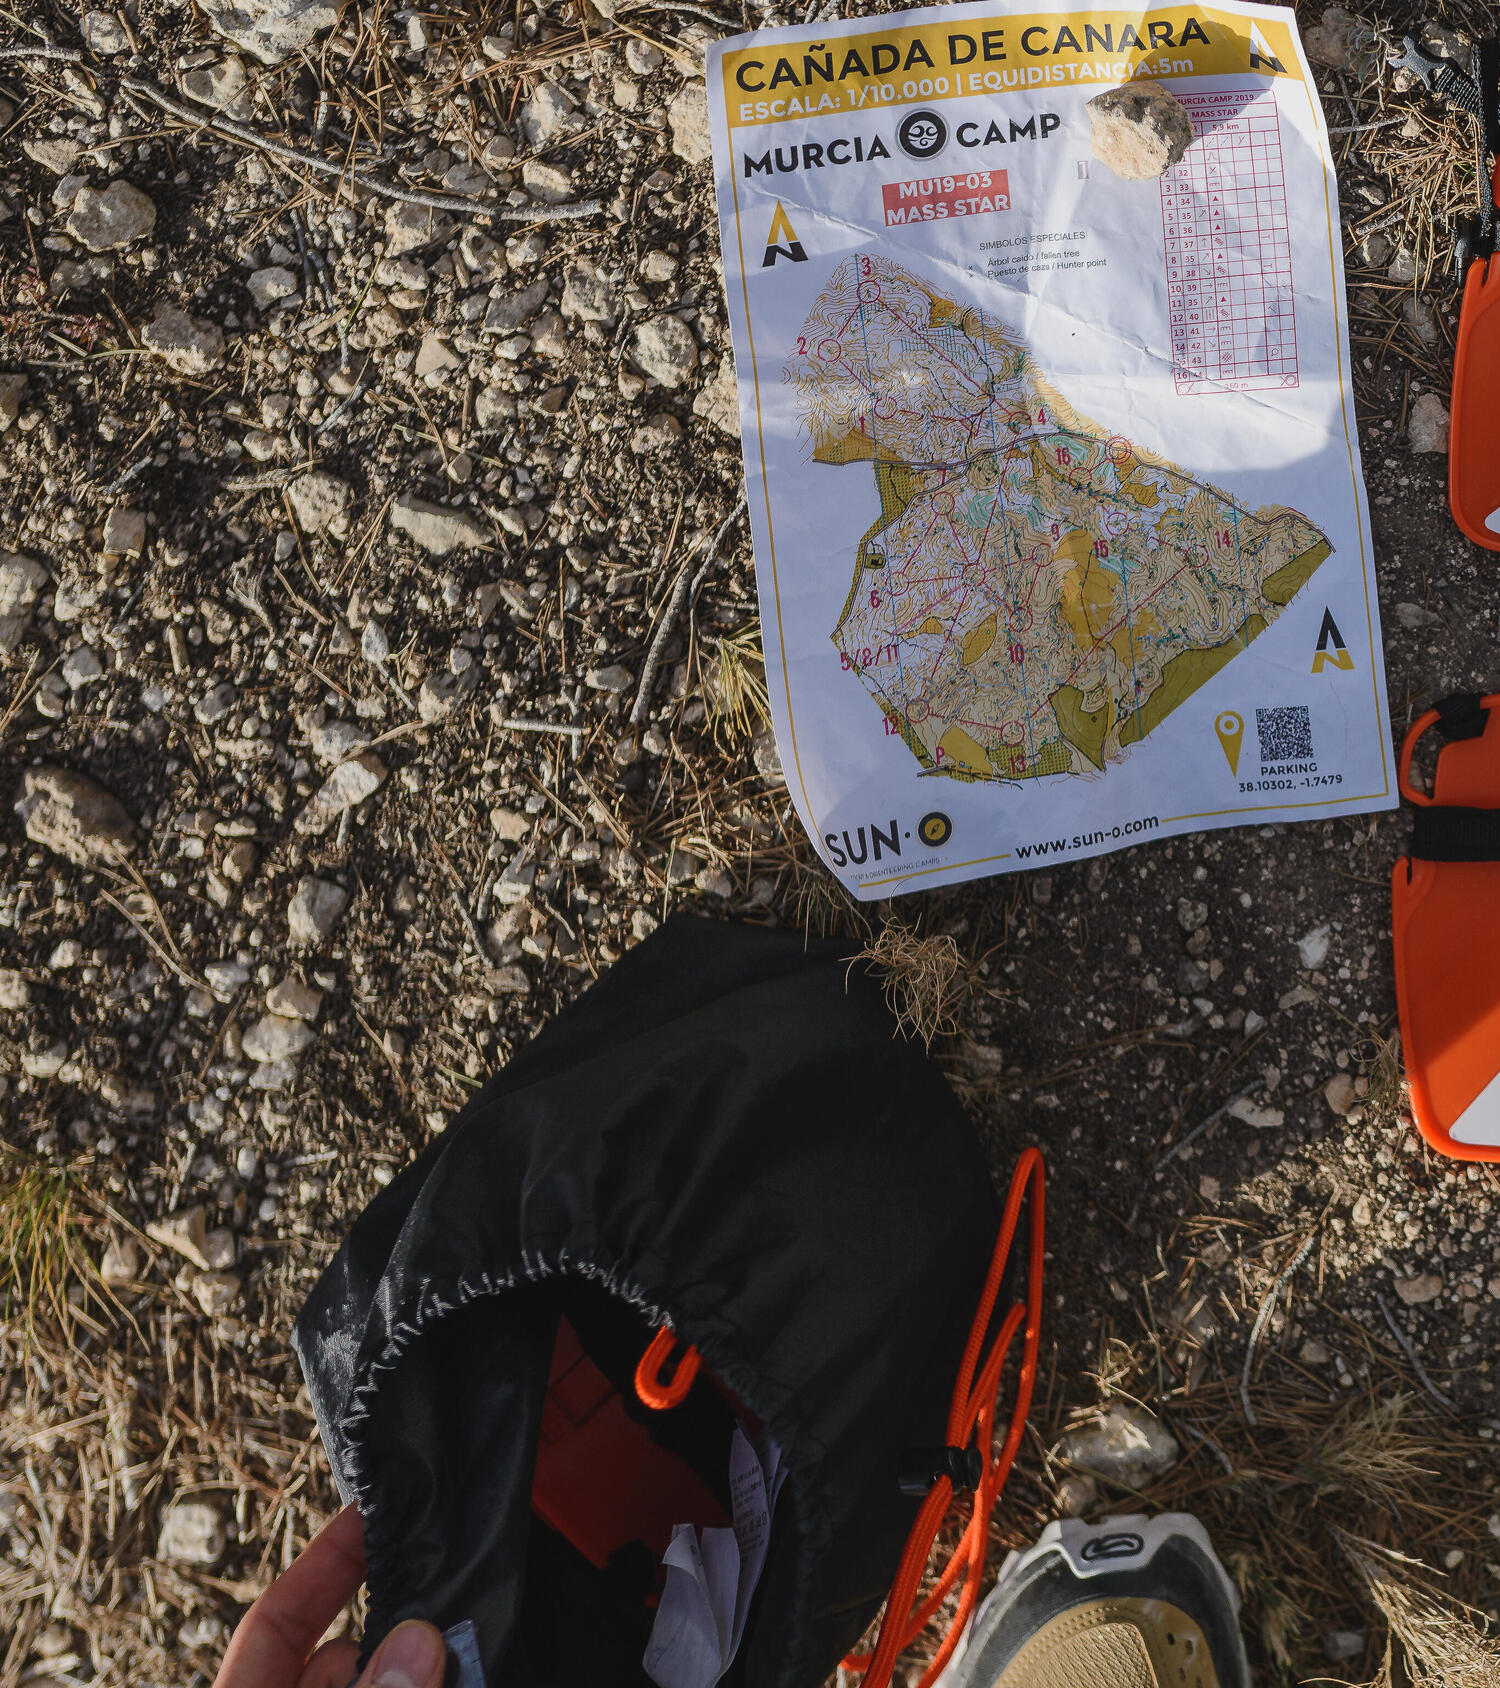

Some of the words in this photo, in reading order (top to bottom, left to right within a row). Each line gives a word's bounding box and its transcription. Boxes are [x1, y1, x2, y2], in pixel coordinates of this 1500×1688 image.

[736, 38, 935, 92] CAÑADA
[948, 29, 1007, 66] DE
[1021, 17, 1211, 57] CANARA
[739, 93, 841, 121] ESCALA:
[846, 76, 950, 108] 1/10.000
[1208, 95, 1233, 104] CAMP
[1235, 94, 1254, 102] 2019
[1191, 110, 1215, 119] MASS
[1217, 108, 1238, 117] STAR
[1226, 122, 1240, 130] km
[743, 134, 891, 178] MURCIA
[956, 113, 1061, 148] CAMP
[1164, 170, 1170, 178] 2
[1178, 169, 1188, 177] 32
[899, 171, 993, 200] MU19-03
[1179, 183, 1190, 191] 33
[1180, 198, 1191, 206] 34
[886, 201, 951, 226] MASS
[954, 194, 1009, 217] STAR
[1168, 213, 1173, 221] 5
[1181, 212, 1192, 220] 35
[1183, 226, 1193, 234] 36
[979, 236, 1028, 251] SIMBOLOS
[1030, 231, 1086, 244] ESPECIALES
[1170, 242, 1176, 250] 7
[1041, 251, 1062, 260] fallen
[1063, 250, 1081, 258] tree
[1171, 256, 1177, 264] 8
[1185, 255, 1195, 263] 35
[861, 256, 871, 276] 3
[987, 267, 1017, 278] Puesto
[1018, 265, 1029, 274] de
[1031, 264, 1050, 272] caza
[1056, 260, 1085, 270] Hunter
[1086, 258, 1107, 269] point
[1172, 271, 1178, 279] 9
[1186, 269, 1196, 277] 38
[1171, 285, 1182, 293] 10
[1187, 284, 1197, 292] 39
[1171, 300, 1182, 308] 11
[1188, 298, 1198, 306] 35
[1173, 314, 1184, 322] 12
[1189, 313, 1200, 321] 40
[1174, 329, 1185, 337] 13
[1190, 327, 1200, 335] 41
[796, 336, 808, 355] 2
[1175, 343, 1186, 351] 14
[1191, 342, 1201, 350] 42
[1192, 356, 1202, 364] 43
[1177, 371, 1188, 379] 16
[1037, 408, 1047, 426] 4
[1055, 447, 1071, 466] 16
[1051, 523, 1060, 542] 9
[1215, 530, 1232, 549] 14
[870, 589, 880, 609] 6
[882, 715, 899, 736] 12
[935, 746, 945, 764] P
[1010, 753, 1027, 774] 13
[1261, 762, 1318, 776] PARKING
[1239, 779, 1297, 793] 38.10302,
[1300, 774, 1343, 788] -1.7479
[1015, 816, 1159, 859] www.sun-o.com
